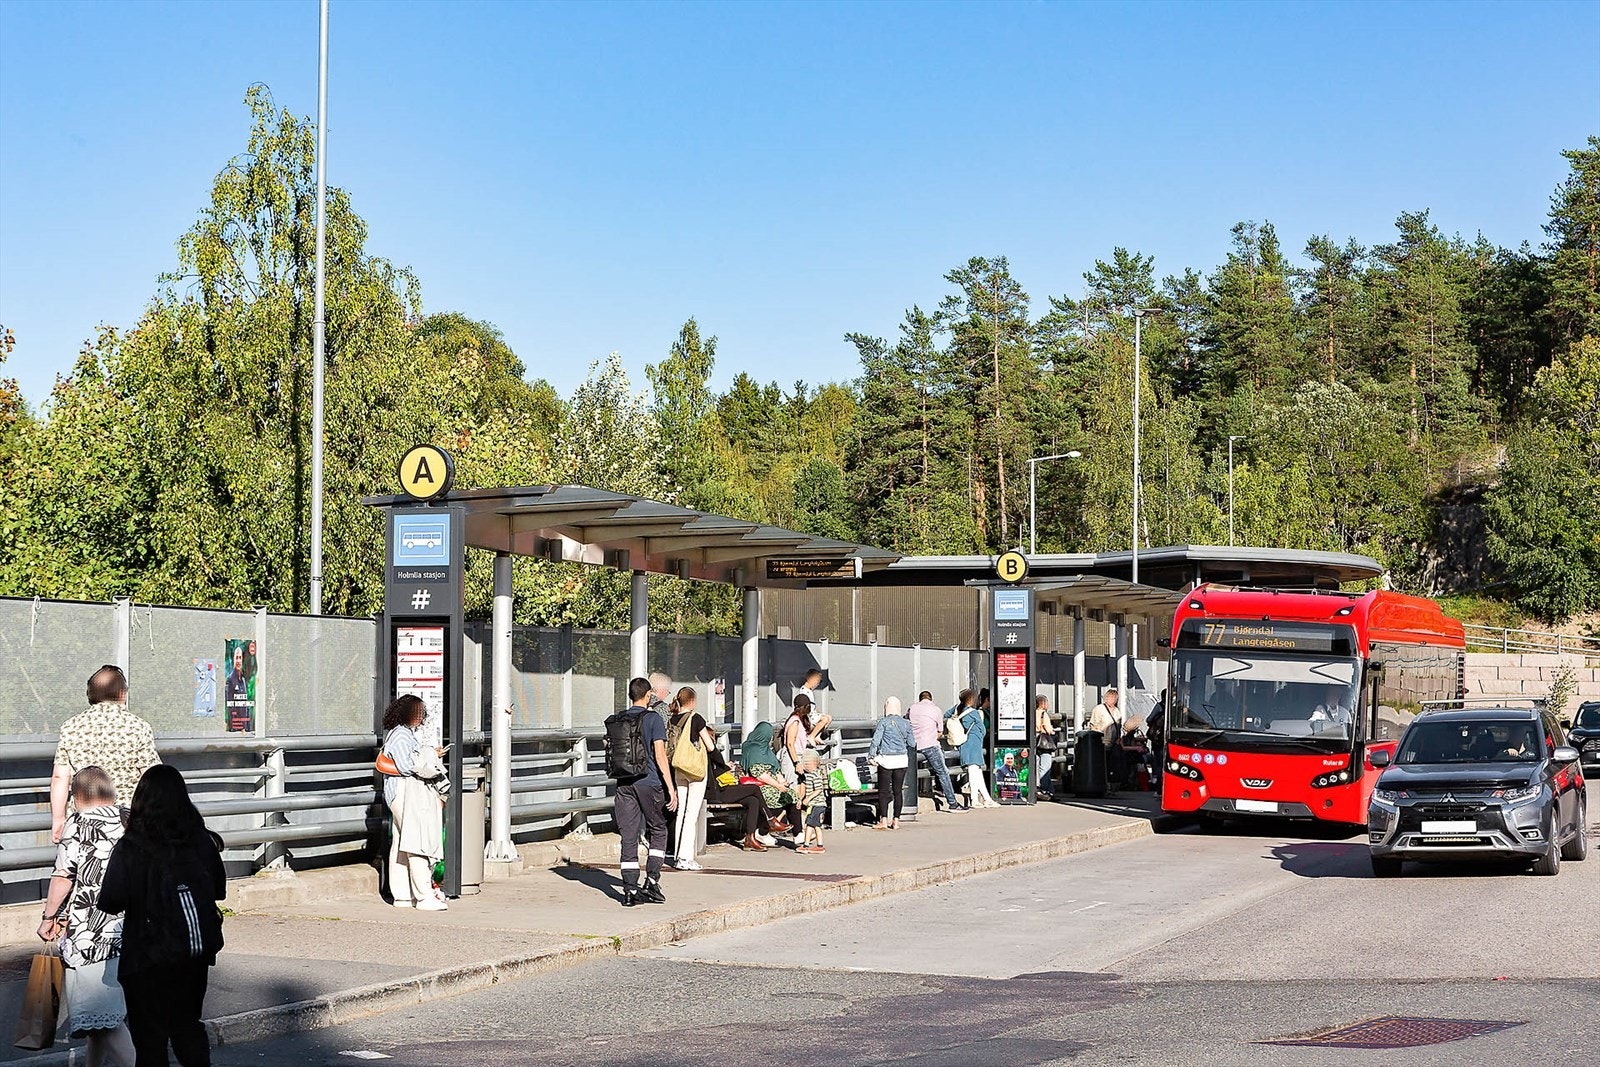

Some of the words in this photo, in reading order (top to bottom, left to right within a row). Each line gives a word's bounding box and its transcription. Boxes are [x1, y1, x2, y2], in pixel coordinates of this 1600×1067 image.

[412, 456, 434, 484] A
[1006, 559, 1018, 575] B
[397, 571, 422, 579] Holmlia
[423, 571, 446, 580] stasjon
[1204, 623, 1226, 645] 77
[1233, 625, 1274, 635] Bjørndal
[1233, 637, 1296, 648] Langteigåsen
[1245, 778, 1268, 787] VDL
